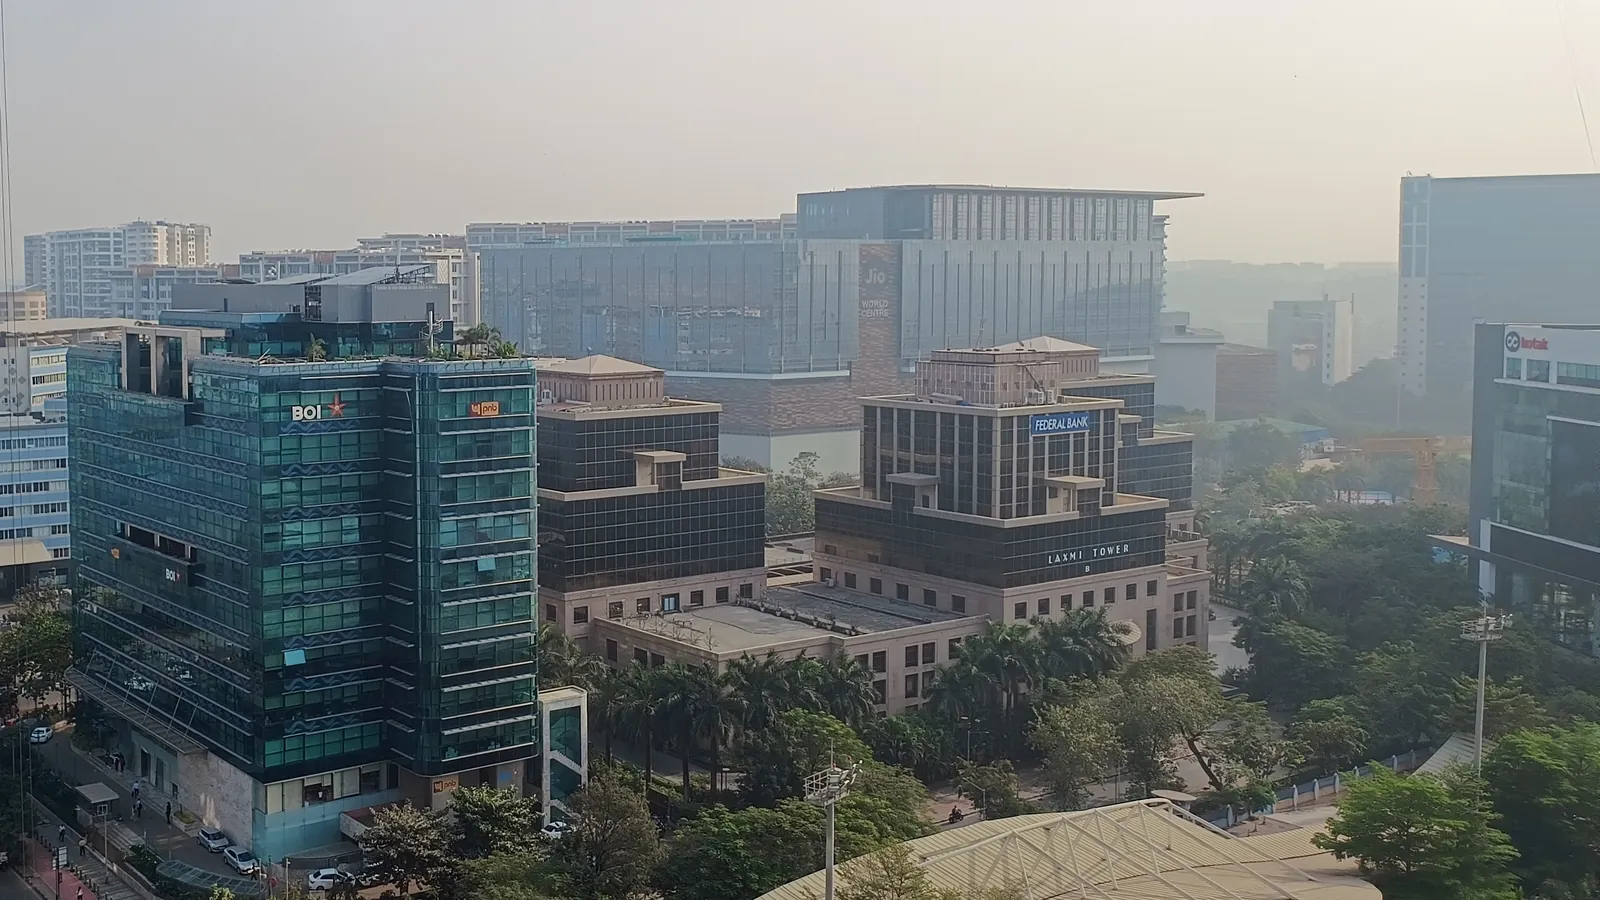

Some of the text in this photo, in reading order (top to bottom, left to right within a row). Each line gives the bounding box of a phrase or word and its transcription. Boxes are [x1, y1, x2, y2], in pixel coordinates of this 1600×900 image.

[865, 267, 886, 284] Jio
[861, 299, 889, 309] WORLD
[861, 309, 889, 318] CENTRE
[292, 404, 322, 421] BOI
[482, 403, 498, 415] pnb
[1035, 416, 1089, 431] FEDERAL BANK
[1048, 544, 1129, 564] LAXMI TOWER
[165, 568, 176, 582] BOI
[1085, 565, 1090, 573] B
